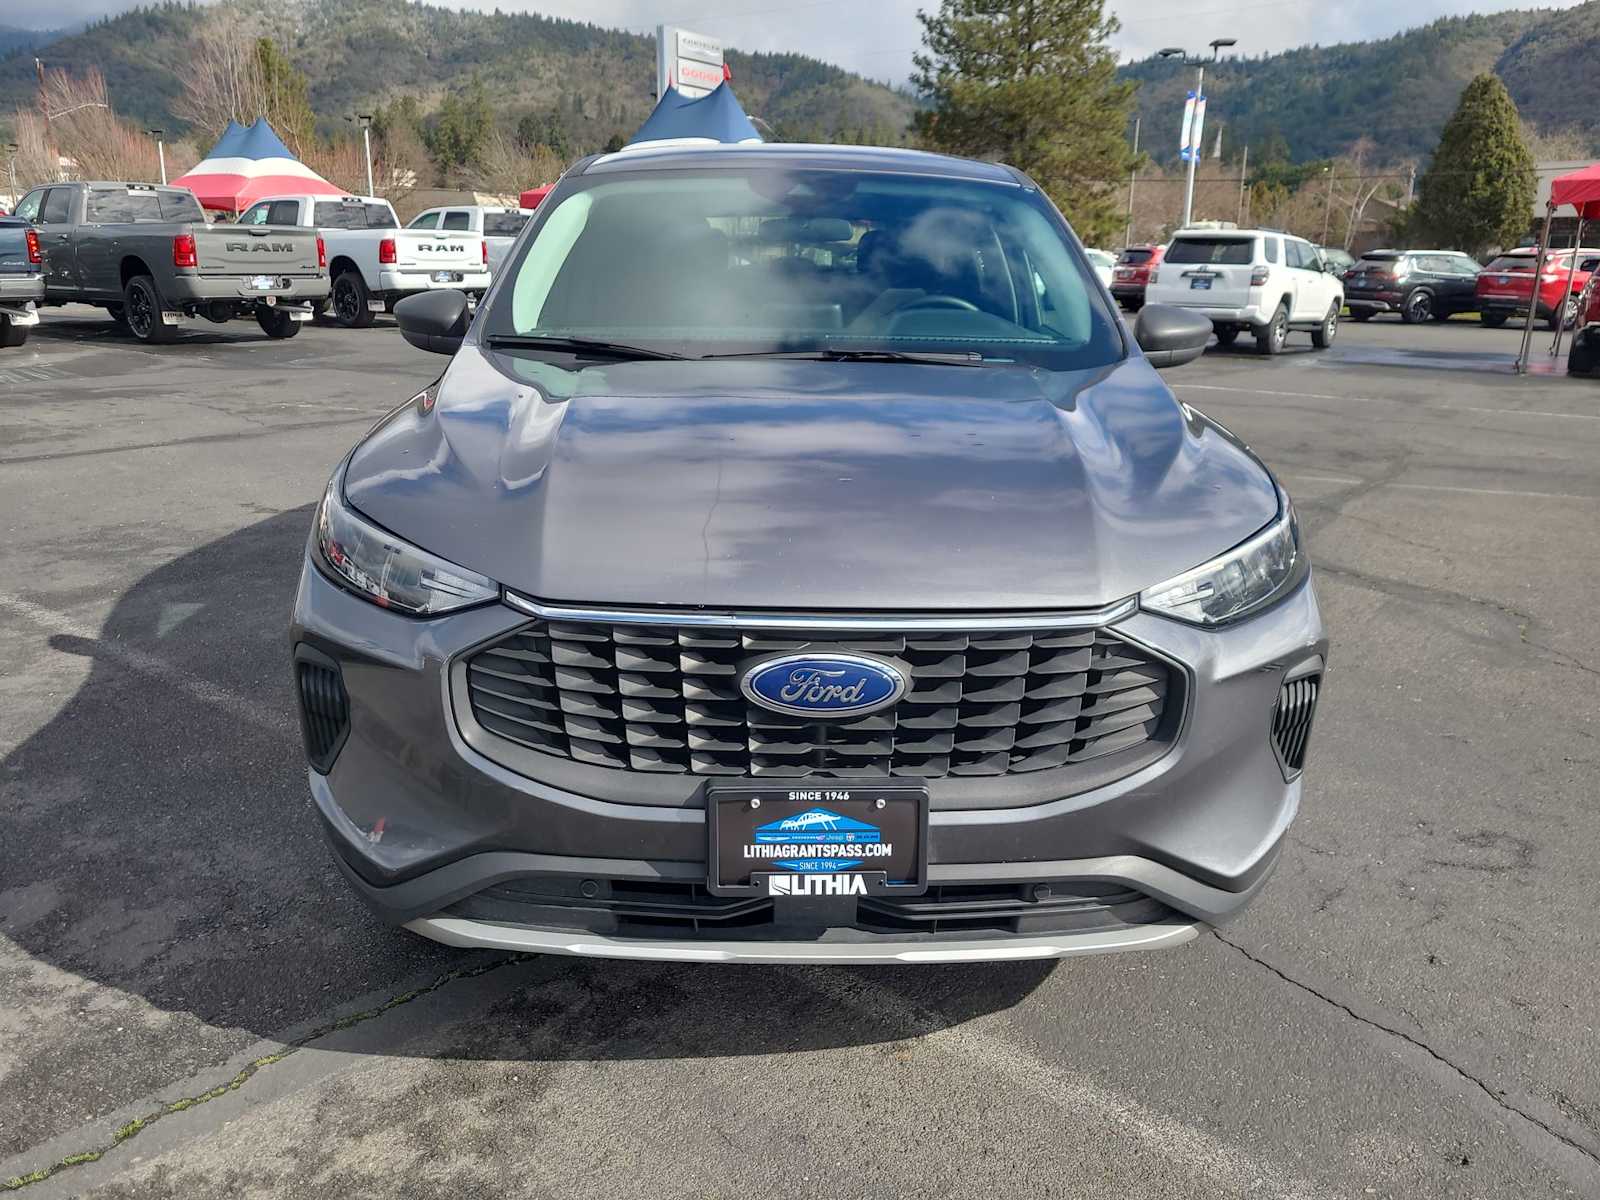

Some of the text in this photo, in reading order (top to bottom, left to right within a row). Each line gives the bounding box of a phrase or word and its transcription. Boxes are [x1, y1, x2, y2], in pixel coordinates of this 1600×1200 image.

[226, 242, 293, 252] RAM
[417, 244, 464, 252] RAM
[780, 667, 867, 703] Ford
[788, 791, 850, 801] SINCE 1946
[743, 843, 892, 858] LITHIAGRANTSPASS.COM
[799, 861, 837, 870] SINCE 1994
[791, 874, 868, 895] LITHIA
